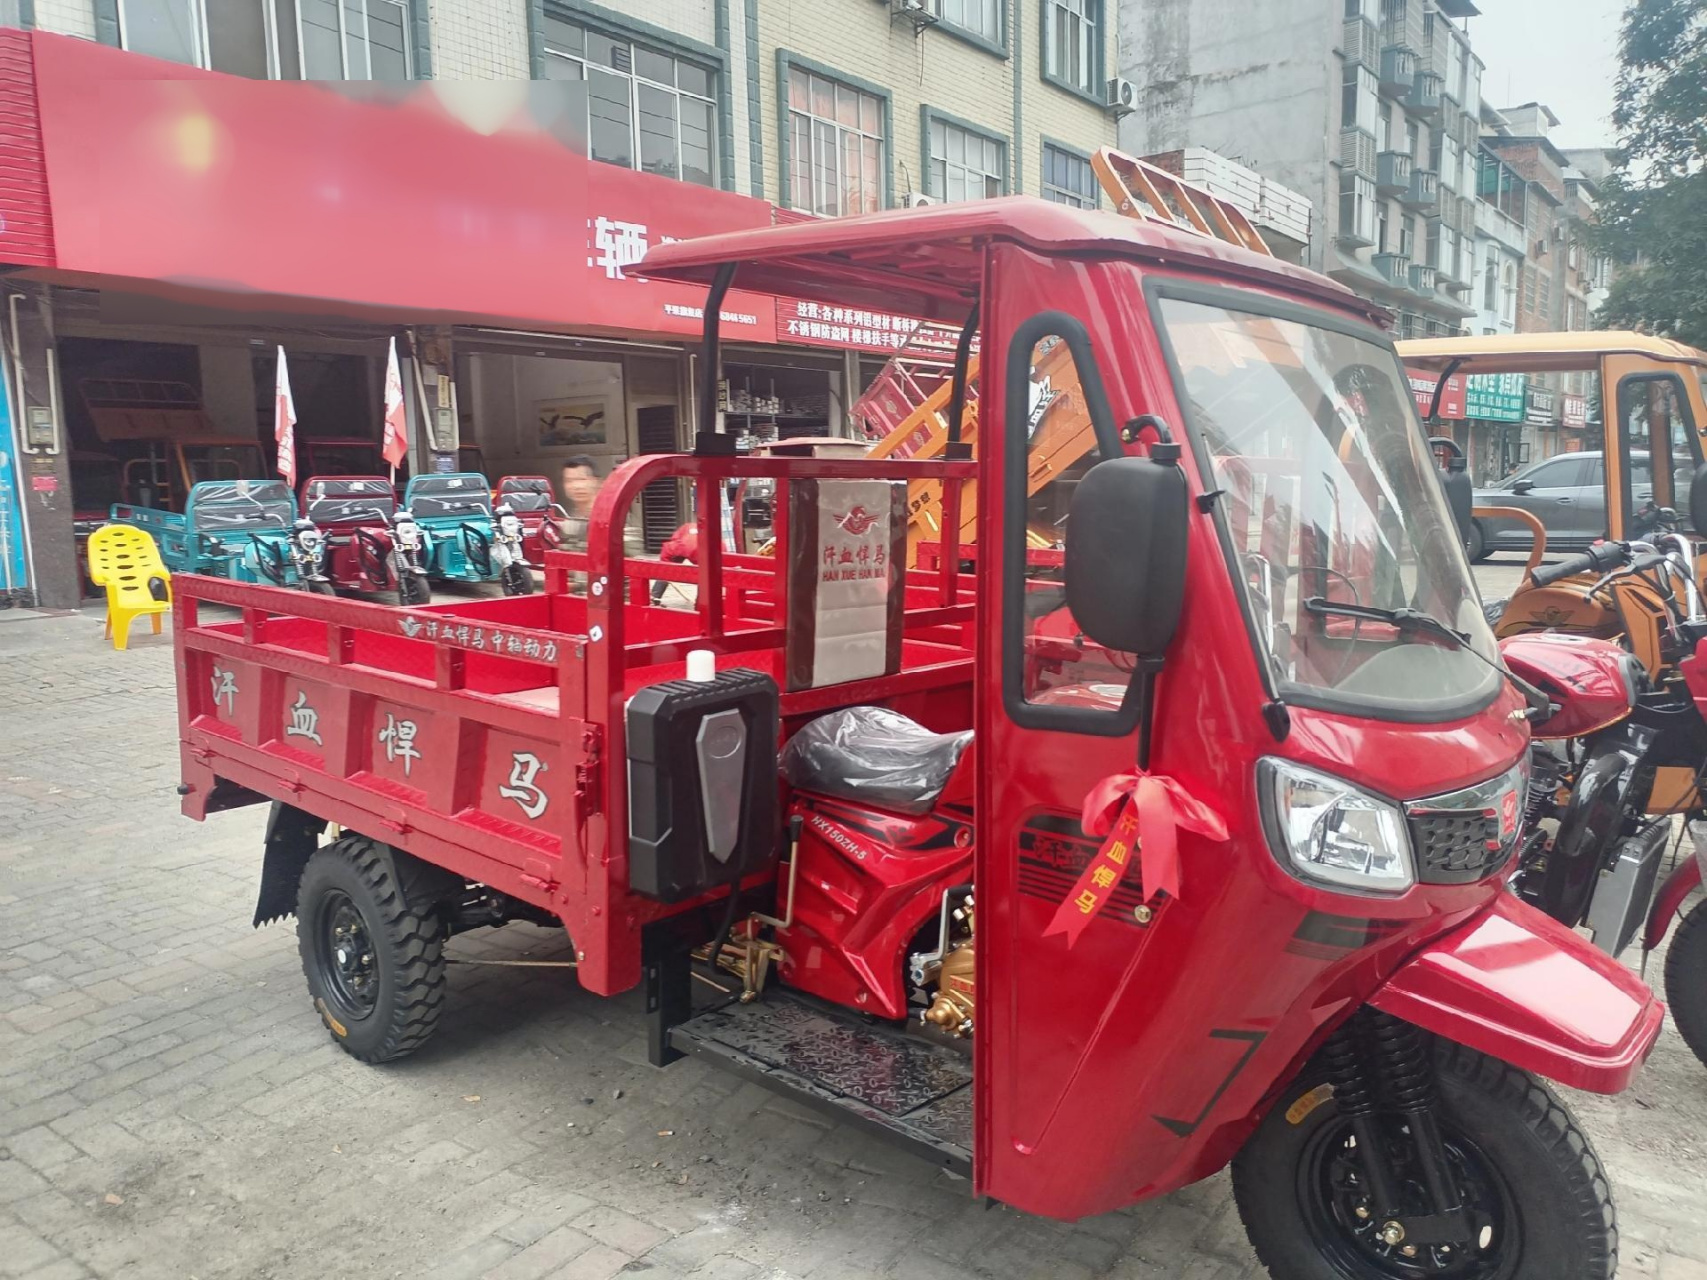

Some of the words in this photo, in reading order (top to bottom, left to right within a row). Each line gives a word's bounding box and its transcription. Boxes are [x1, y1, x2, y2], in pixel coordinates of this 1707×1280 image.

[822, 570, 839, 582] HAN
[426, 621, 484, 648] 汗血悍马
[811, 815, 868, 860] HX150ZH-5
